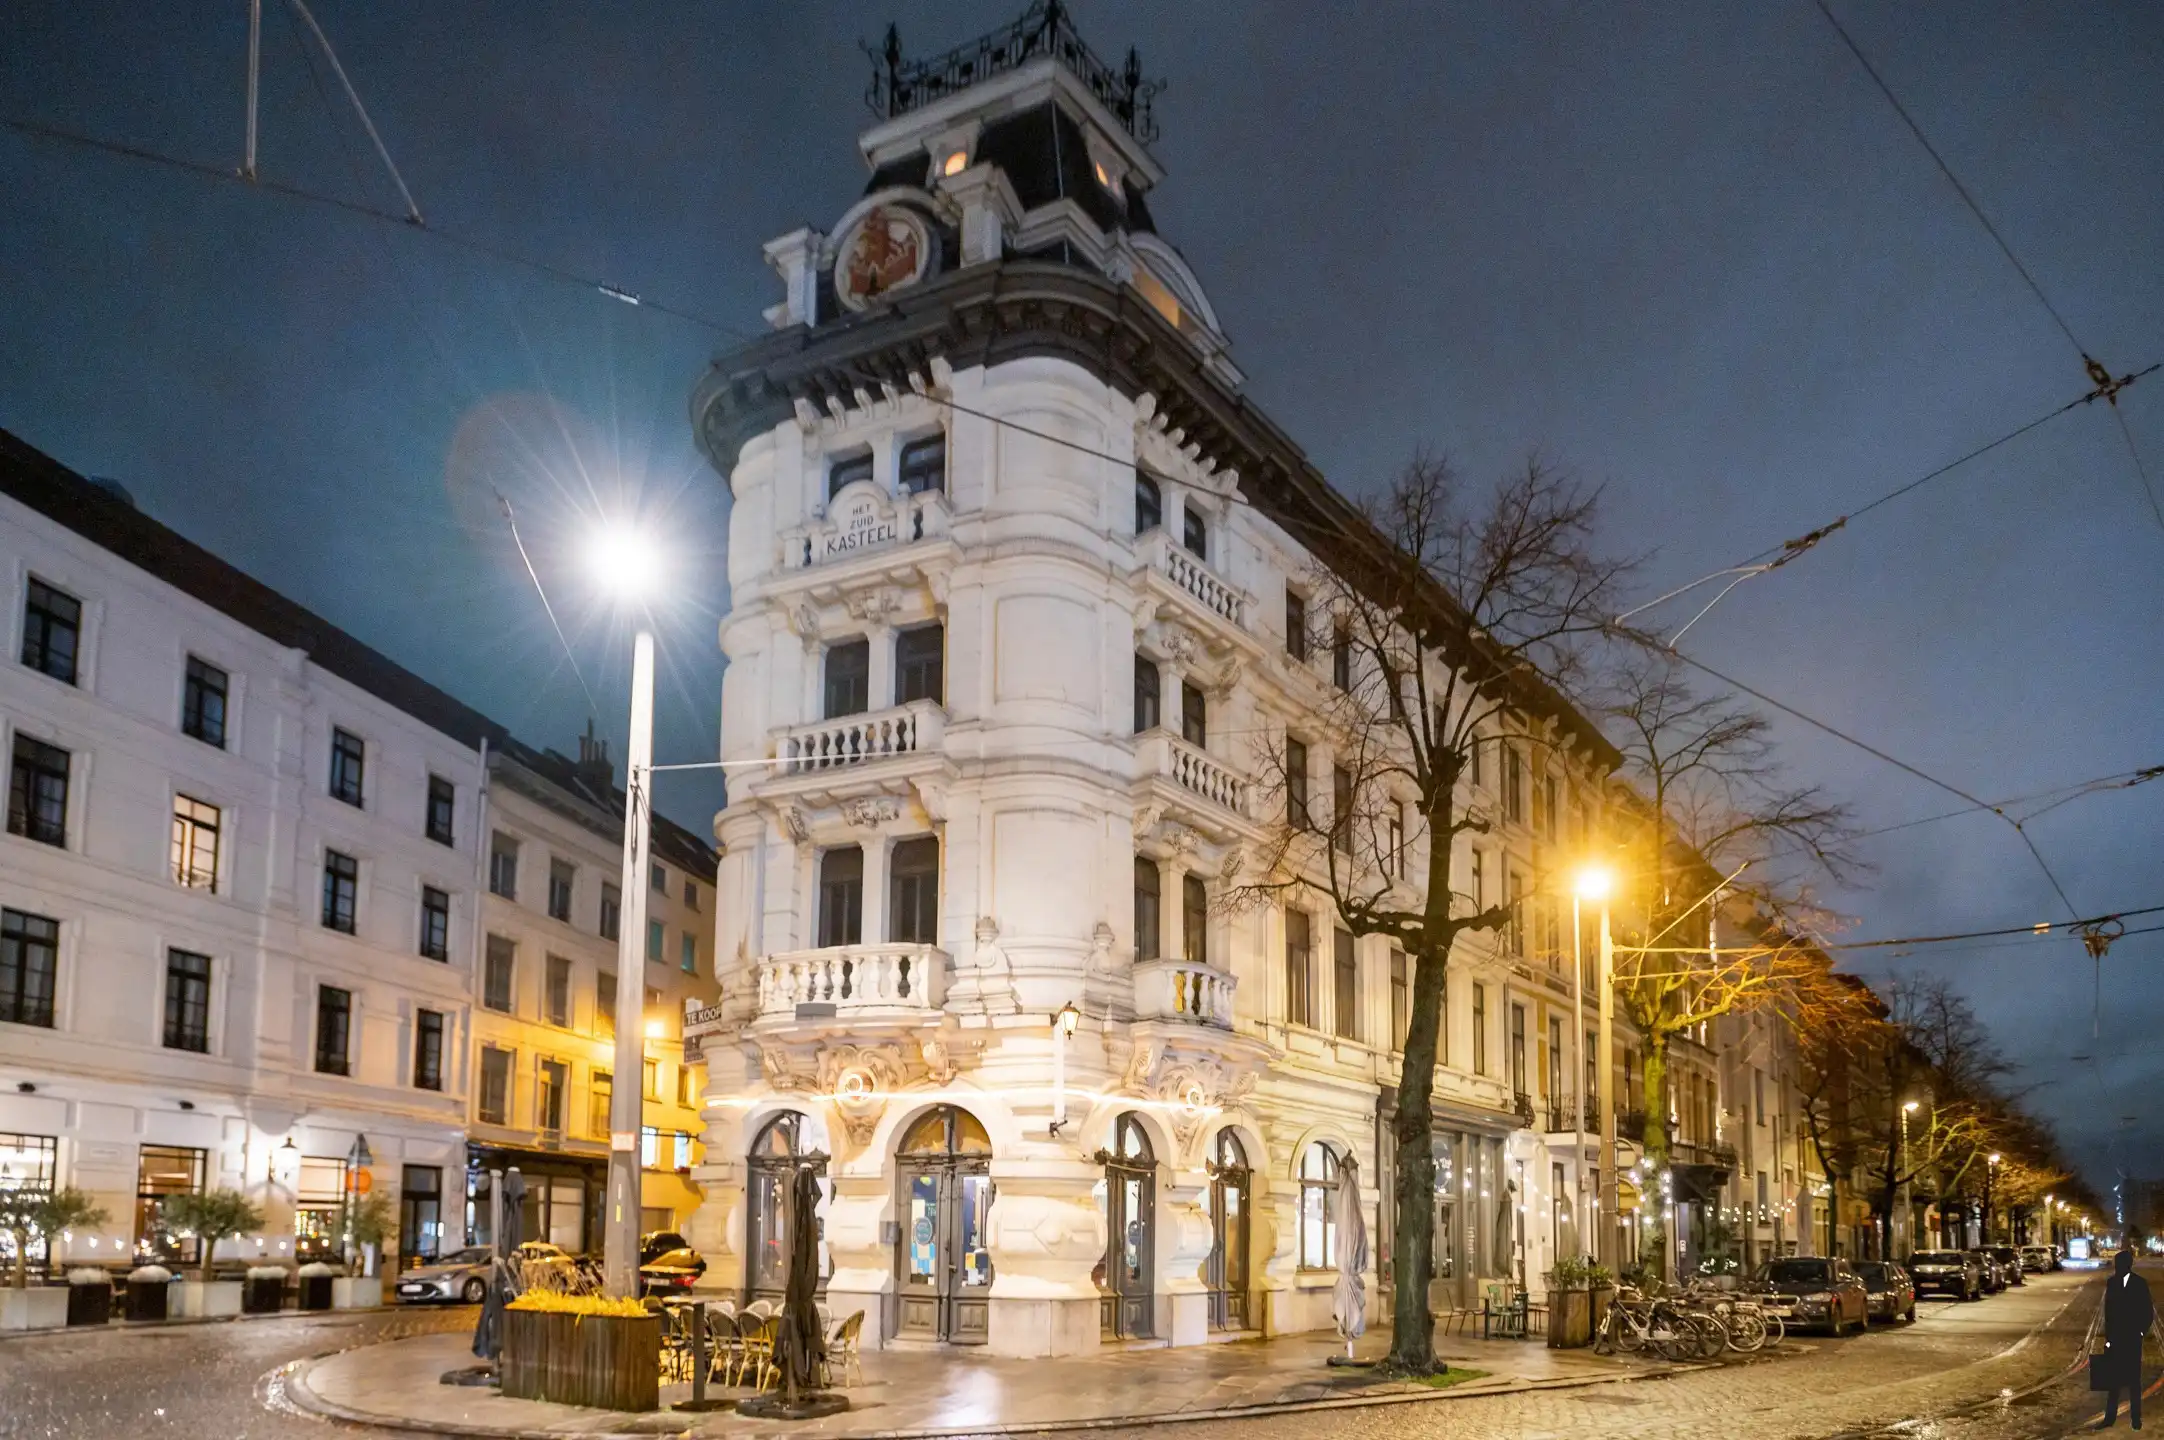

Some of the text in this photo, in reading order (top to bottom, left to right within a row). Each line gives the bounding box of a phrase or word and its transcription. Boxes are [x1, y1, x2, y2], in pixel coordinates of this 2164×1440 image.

[853, 503, 870, 516] HET
[850, 515, 874, 530] ZUID
[827, 524, 897, 555] KASTEEL
[687, 1013, 697, 1026] TE
